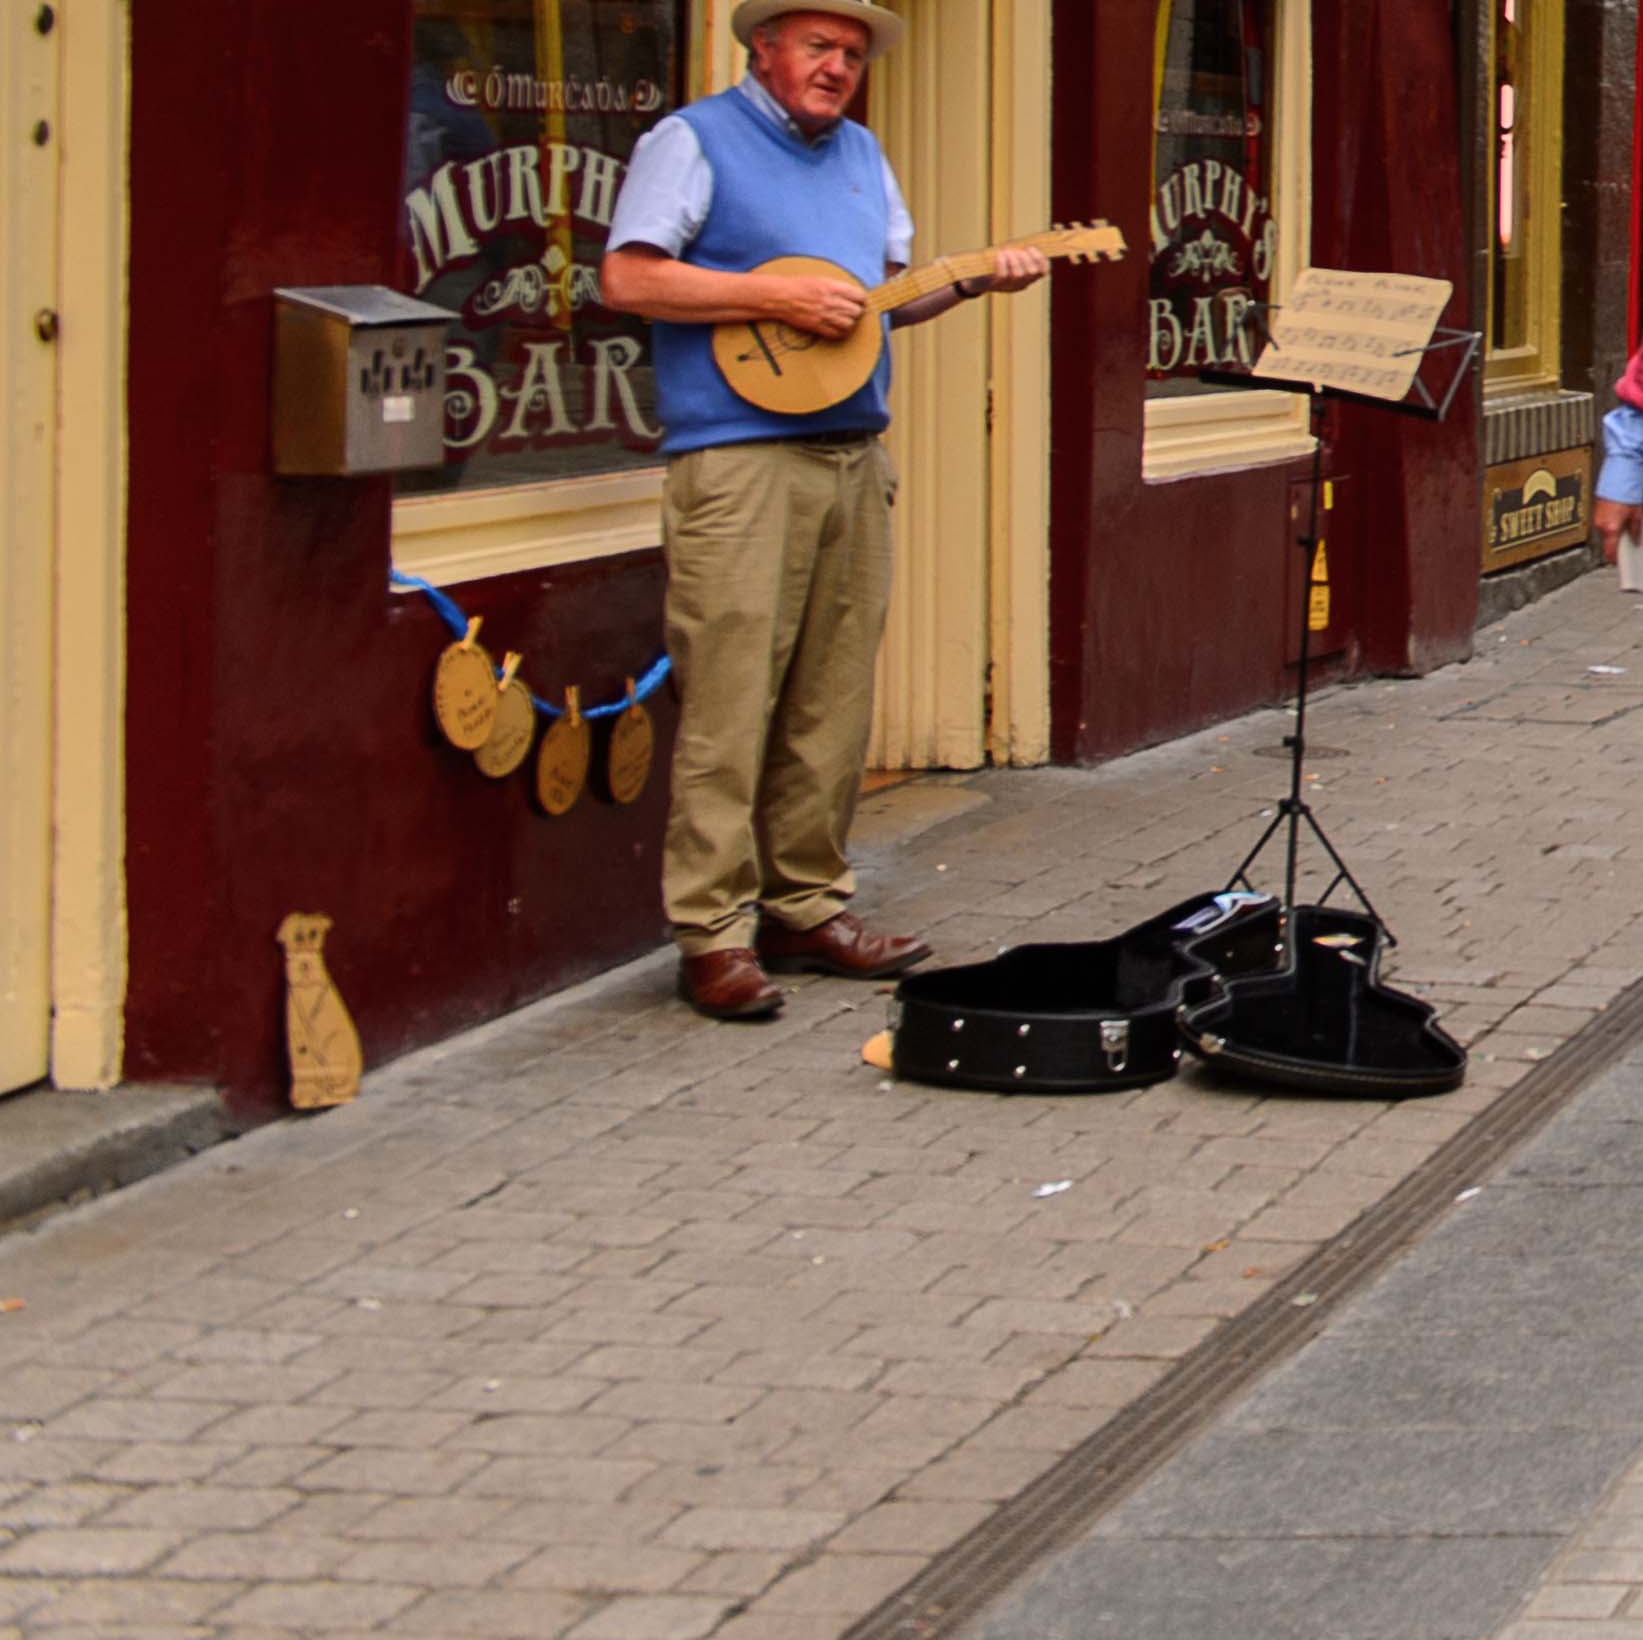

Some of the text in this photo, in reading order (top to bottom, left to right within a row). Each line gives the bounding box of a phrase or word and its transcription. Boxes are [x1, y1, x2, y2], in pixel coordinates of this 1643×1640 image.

[405, 144, 627, 292] MURPH
[1147, 297, 1252, 370] BAR
[442, 336, 663, 449] BAR
[1501, 504, 1544, 542] SWEET
